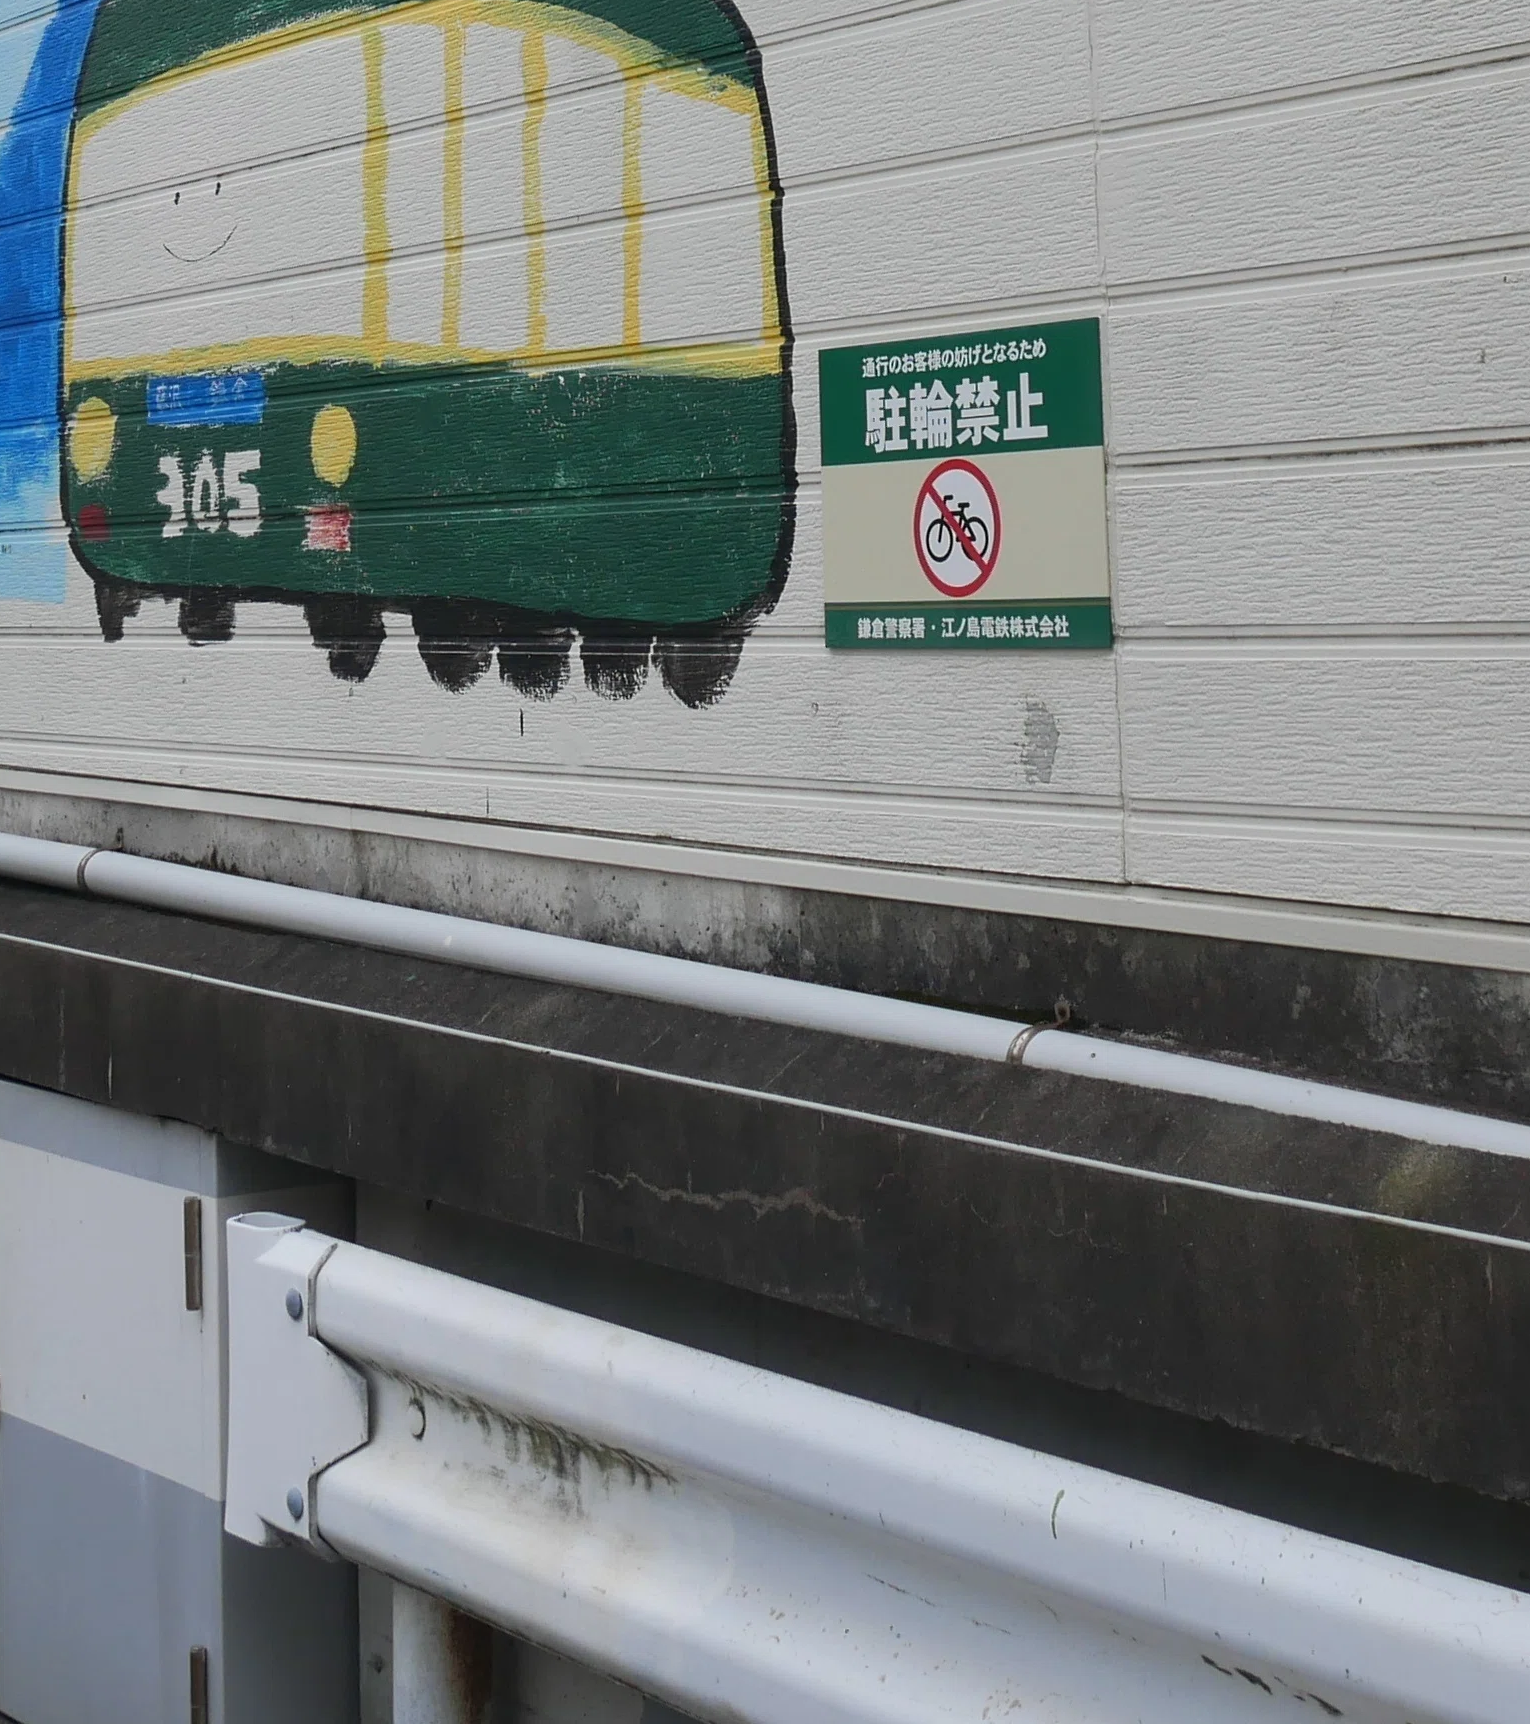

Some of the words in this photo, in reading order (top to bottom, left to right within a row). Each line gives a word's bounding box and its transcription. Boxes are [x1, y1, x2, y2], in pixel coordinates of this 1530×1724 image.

[862, 338, 1047, 379] 通行のお客様の妨げとなるため
[864, 372, 1049, 453] 駐輪禁止
[156, 447, 263, 538] 305
[857, 615, 1070, 640] 鎌倉警察署・江ノ島電鉄株式会社
